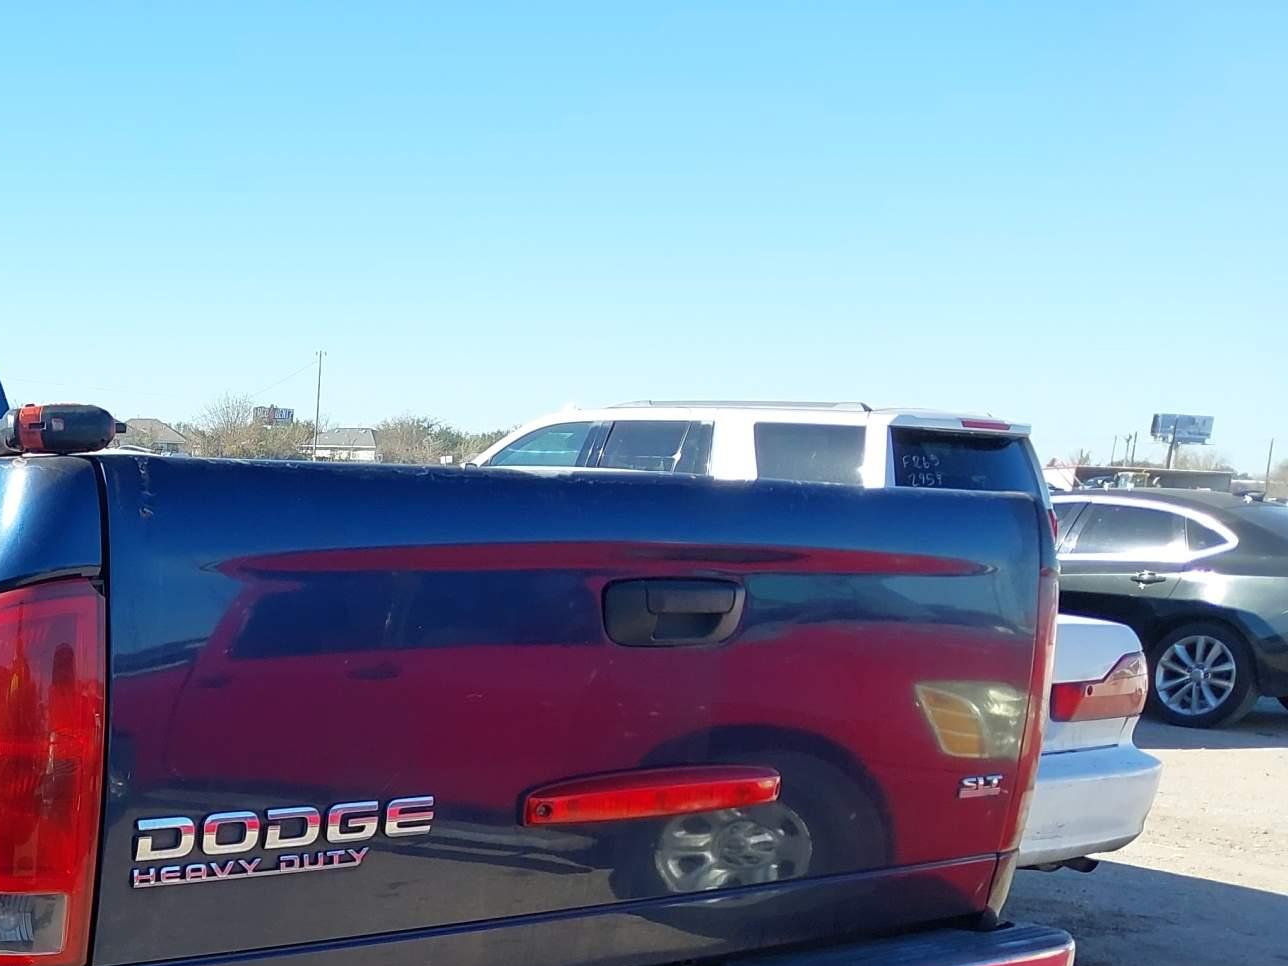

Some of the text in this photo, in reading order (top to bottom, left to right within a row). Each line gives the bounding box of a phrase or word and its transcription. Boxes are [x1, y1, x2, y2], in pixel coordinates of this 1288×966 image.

[960, 774, 1003, 793] SLT
[134, 796, 434, 862] DODGE
[132, 847, 369, 886] HEAVY DUTY
